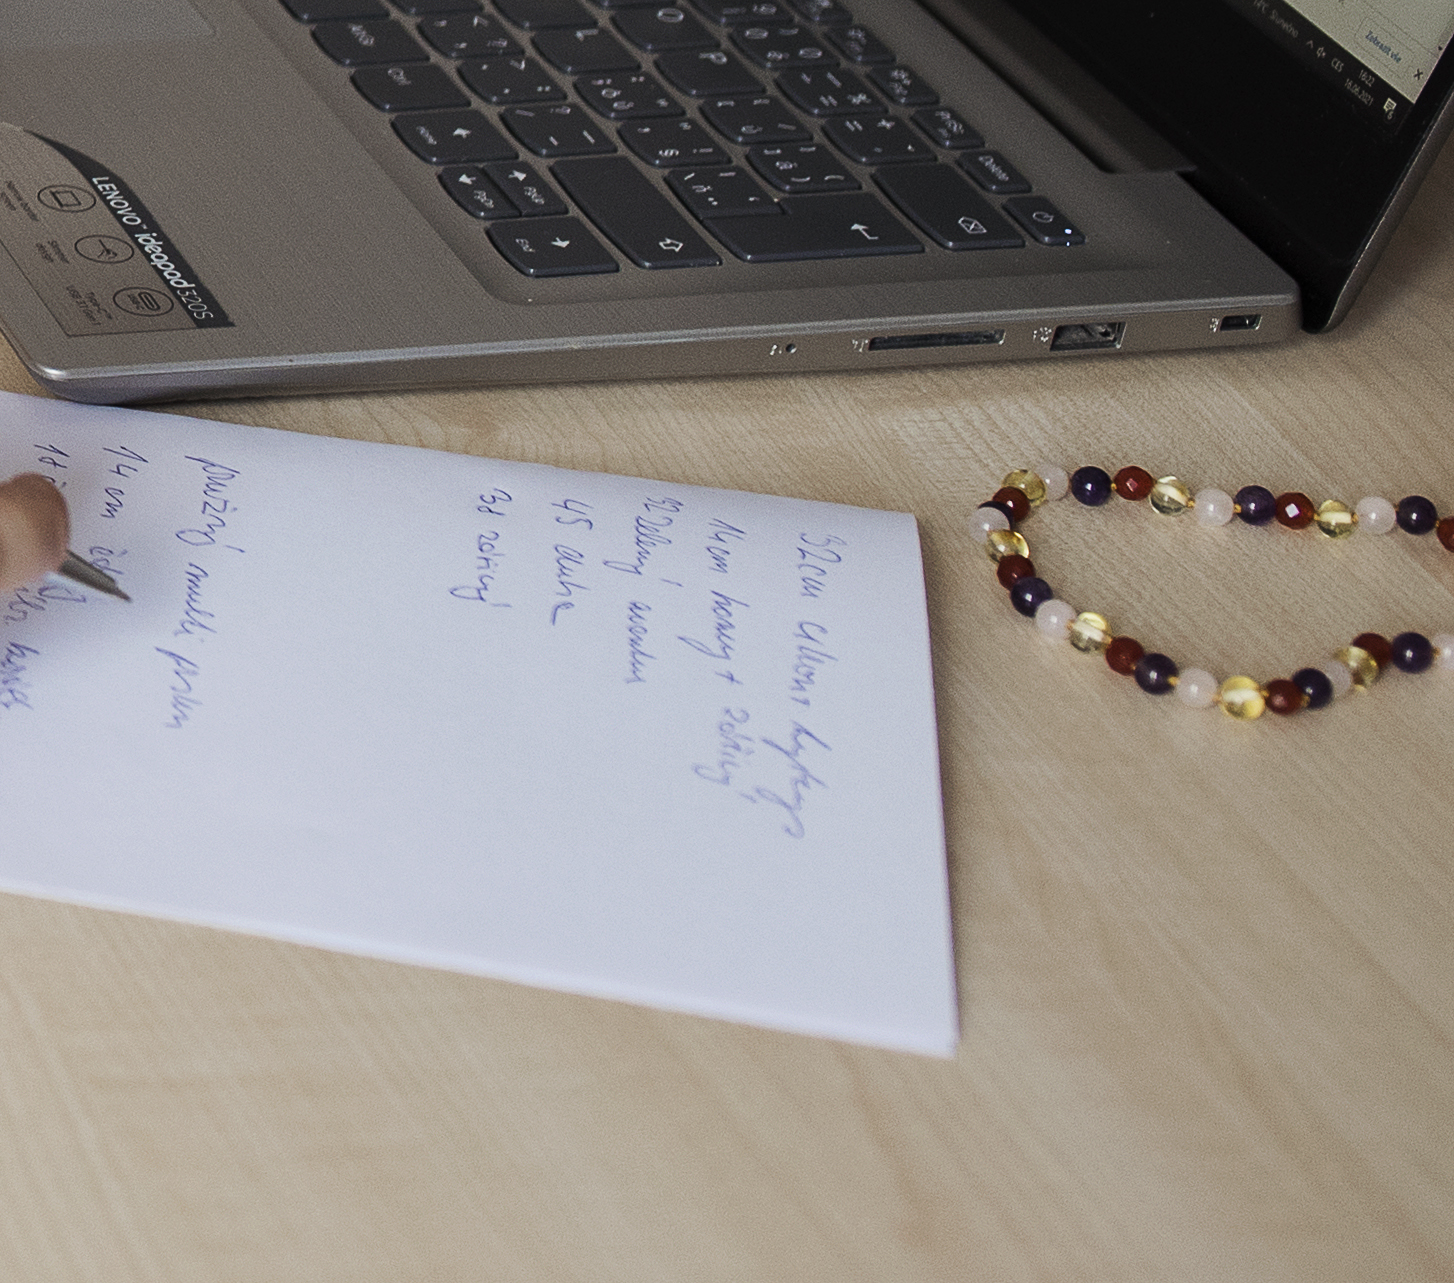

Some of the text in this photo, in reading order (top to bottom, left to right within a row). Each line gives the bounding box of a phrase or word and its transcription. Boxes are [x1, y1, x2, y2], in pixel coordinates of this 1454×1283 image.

[656, 8, 685, 23] O
[700, 52, 728, 64] P
[551, 496, 594, 532] 45
